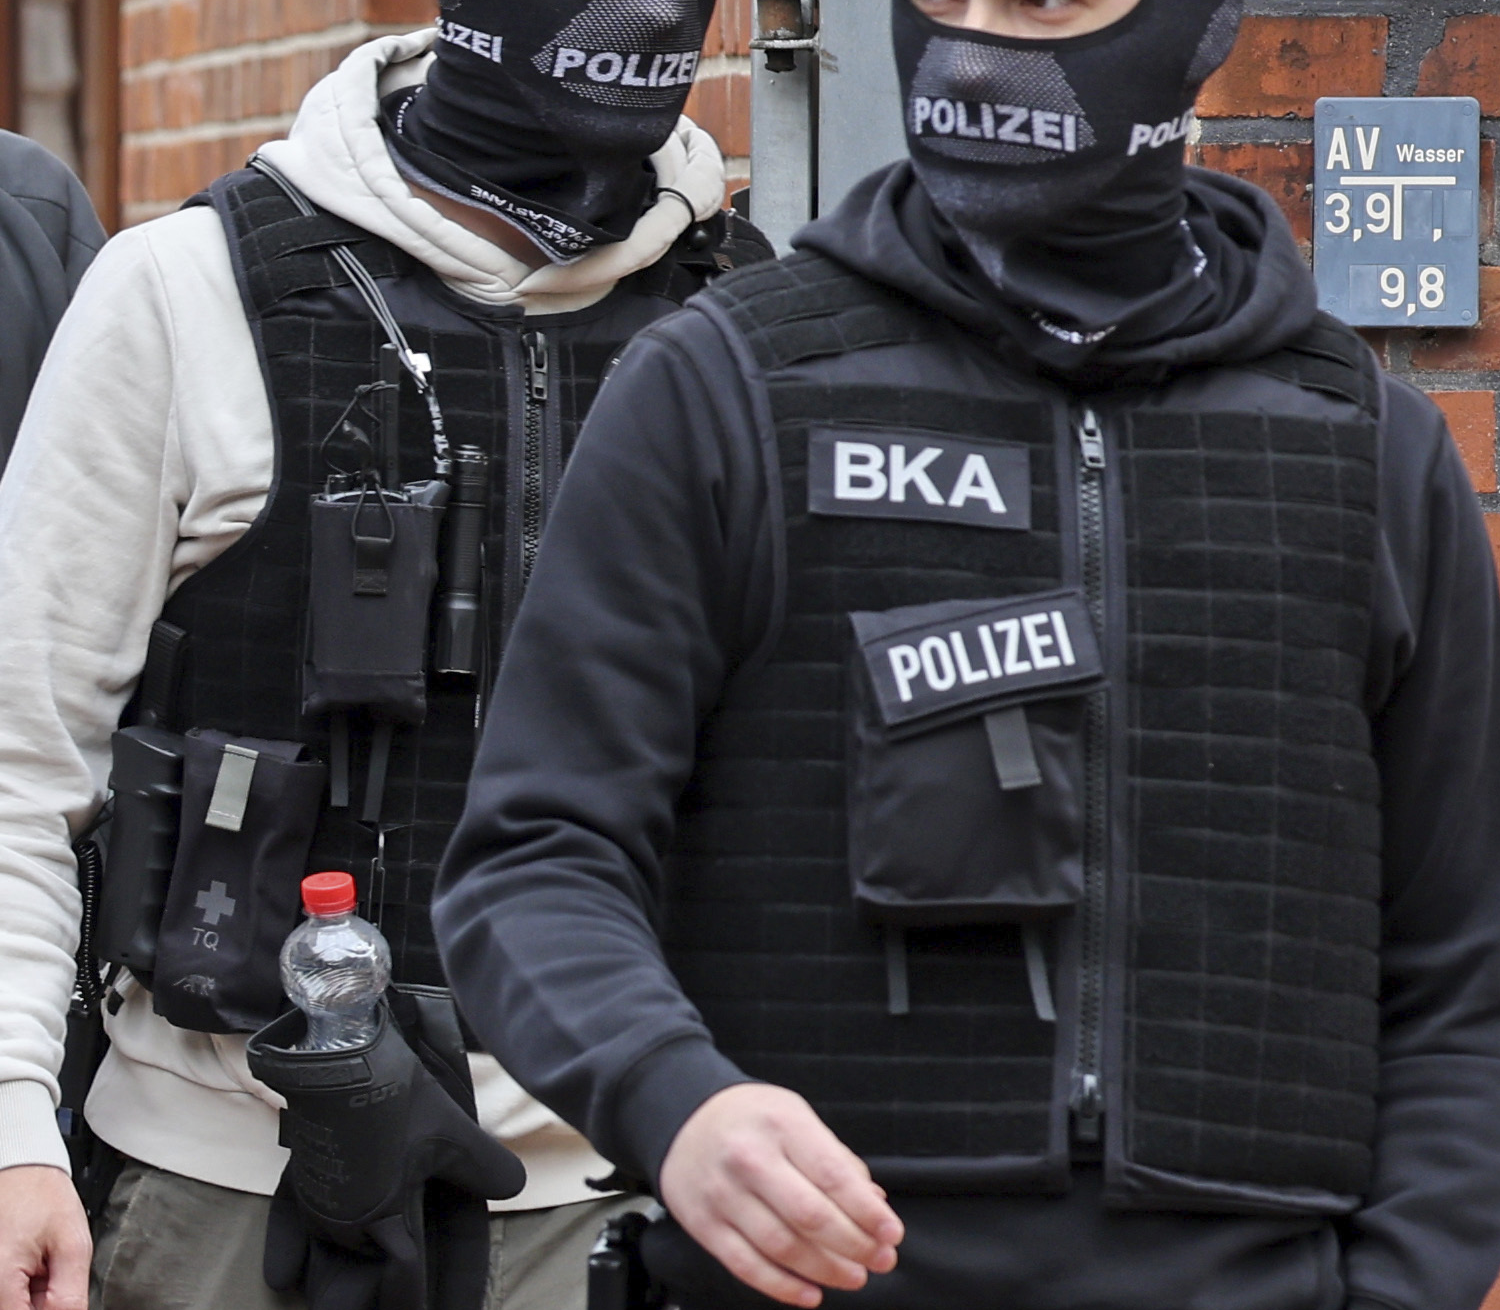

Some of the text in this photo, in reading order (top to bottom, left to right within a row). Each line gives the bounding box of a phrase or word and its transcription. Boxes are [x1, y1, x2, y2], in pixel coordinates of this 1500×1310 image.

[552, 47, 700, 87] POLIZEI
[914, 96, 1077, 153] POLIZEI
[1326, 127, 1465, 171] AV Wasser
[1325, 192, 1392, 242] 3,9
[1379, 266, 1445, 317] 9,8
[833, 439, 1008, 515] BKA
[887, 609, 1077, 704] POLIZEI
[192, 927, 220, 951] TQ
